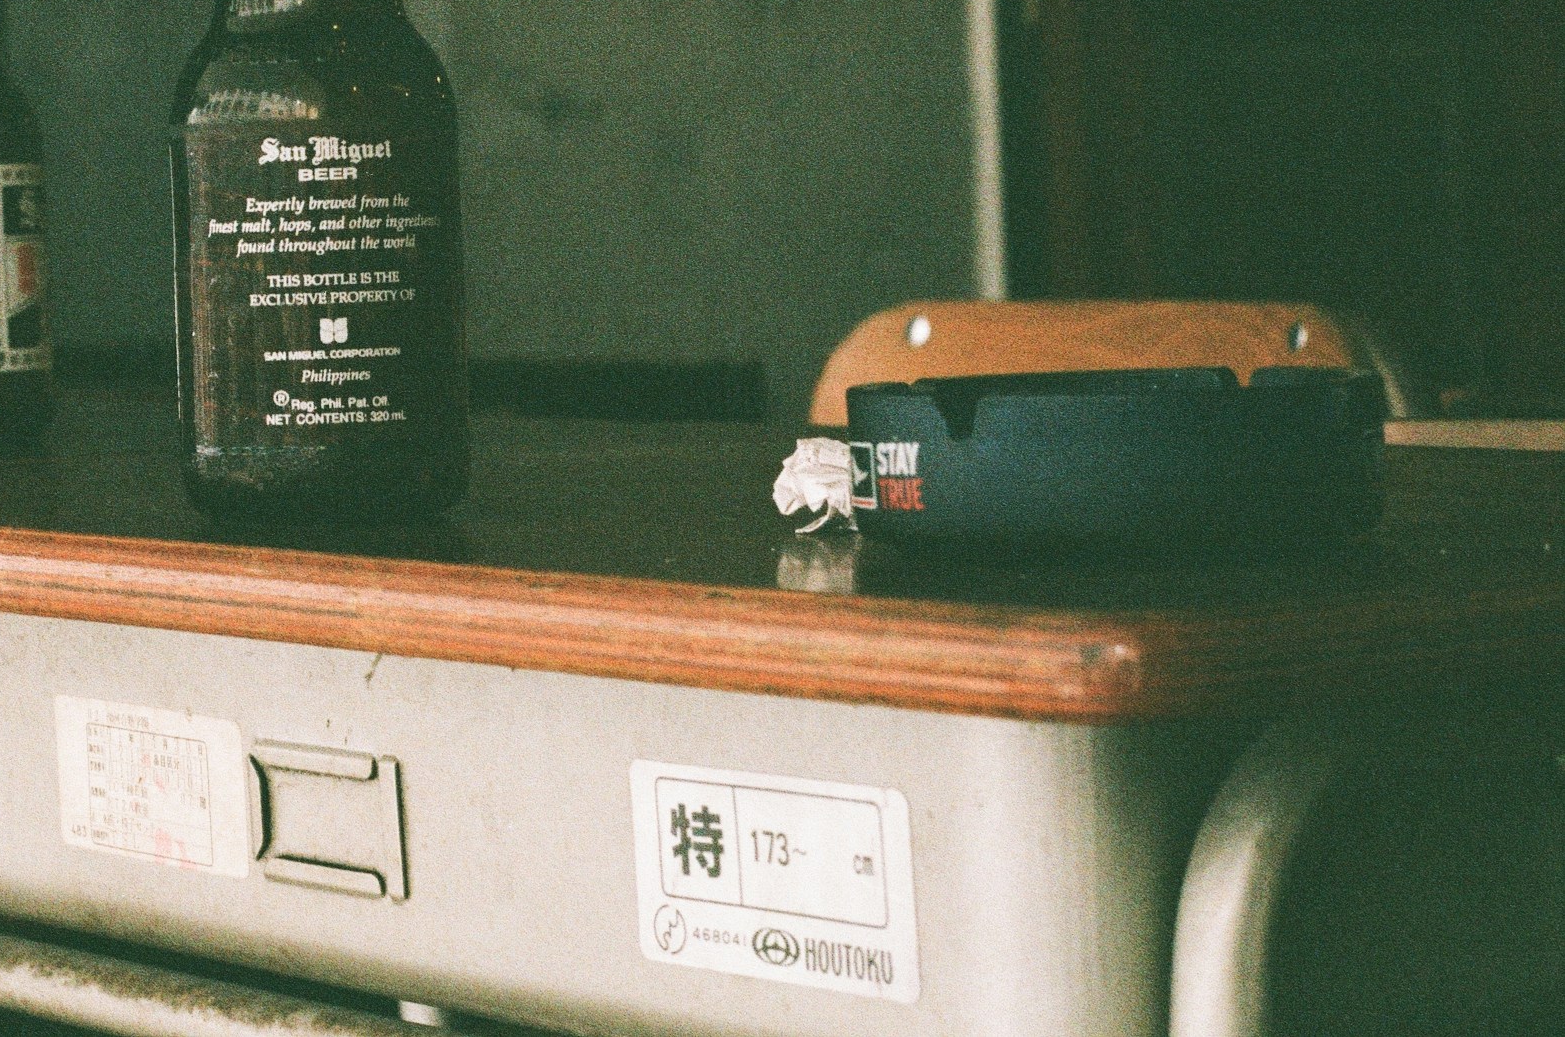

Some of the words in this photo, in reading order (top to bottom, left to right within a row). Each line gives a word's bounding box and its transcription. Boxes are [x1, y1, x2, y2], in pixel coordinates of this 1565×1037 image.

[259, 137, 307, 165] San
[309, 136, 392, 165] Miguel
[298, 167, 358, 182] BEER
[246, 197, 305, 215] Expertly
[309, 195, 357, 211] brewed
[359, 195, 389, 212] from
[393, 193, 410, 208] the
[208, 219, 239, 238] finest
[242, 218, 276, 234] malt,
[279, 218, 316, 236] hops,
[319, 216, 345, 230] and
[349, 215, 383, 229] other
[236, 239, 275, 258] found
[279, 237, 357, 255] throughout
[360, 236, 379, 250] the
[383, 235, 416, 249] world
[267, 275, 301, 288] THIS
[303, 273, 357, 287] BOTTLE
[360, 272, 372, 284] IS
[374, 271, 400, 283] THE
[249, 292, 327, 307] EXCLUSIVE
[330, 290, 397, 304] PROPERTY
[400, 288, 416, 301] OF
[264, 352, 286, 362] SAN
[288, 350, 328, 361] MIGUEL
[329, 347, 401, 359] CORPORATION
[301, 368, 371, 386] Philippines
[321, 398, 344, 409] Phil.
[348, 397, 369, 408] Pat.
[266, 414, 291, 426] NET
[296, 412, 367, 425] CONTENTS:
[370, 411, 389, 422] 320
[877, 442, 920, 476] STAY
[877, 477, 925, 510] TRUE
[670, 803, 724, 878] 特
[804, 937, 894, 985] HOUTOKU
